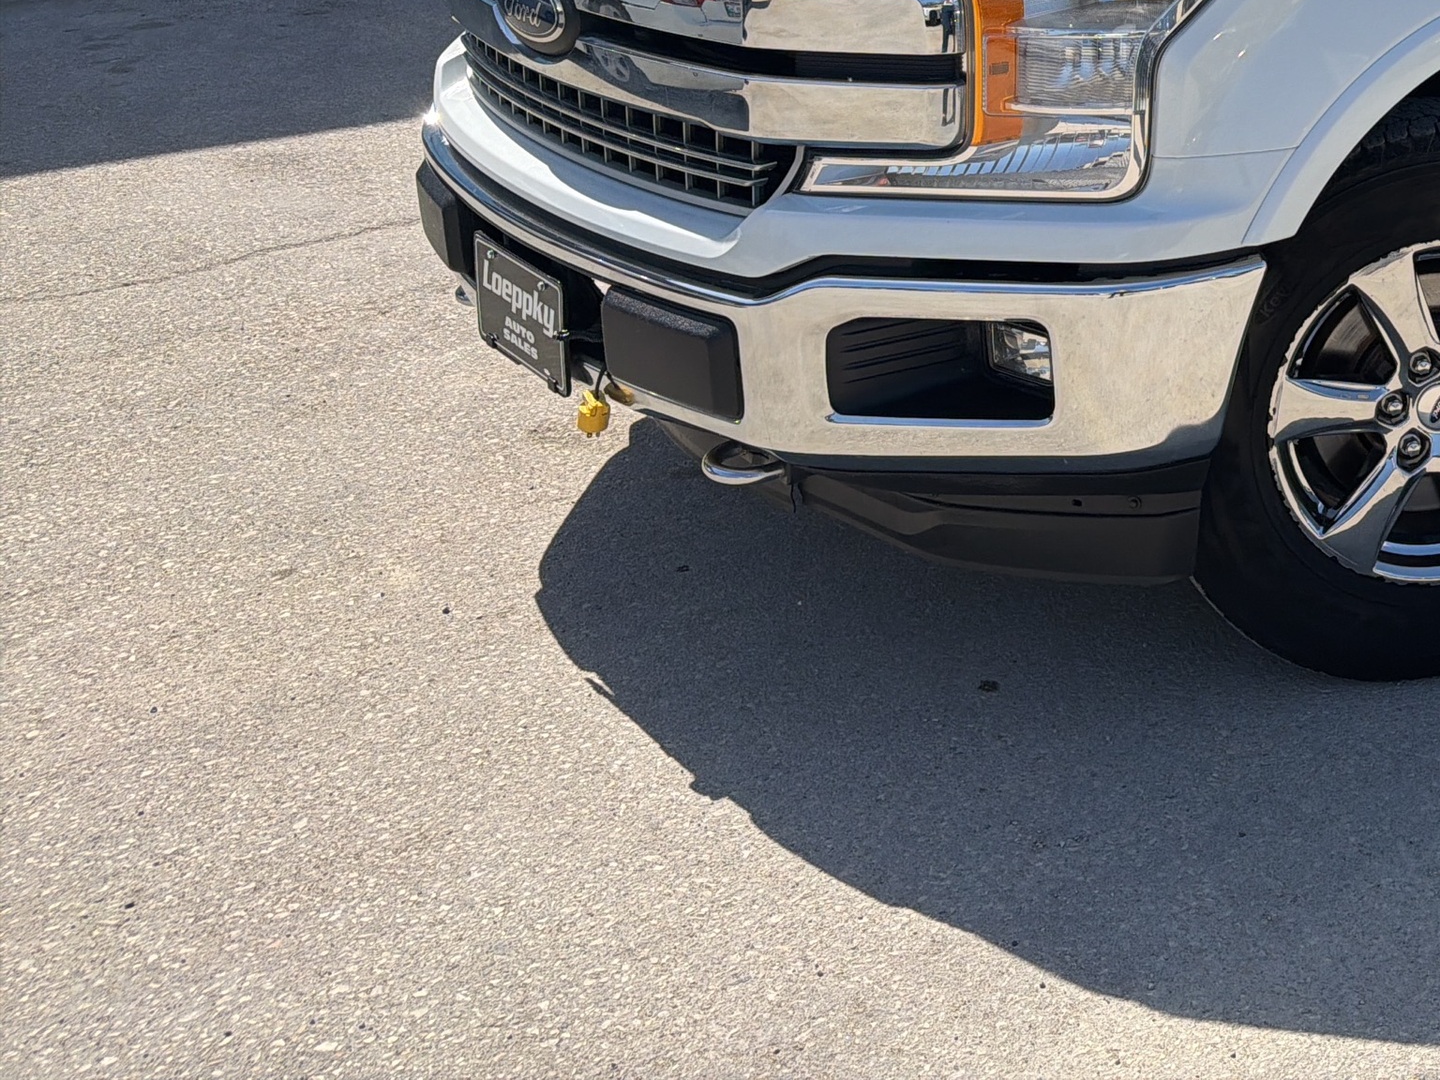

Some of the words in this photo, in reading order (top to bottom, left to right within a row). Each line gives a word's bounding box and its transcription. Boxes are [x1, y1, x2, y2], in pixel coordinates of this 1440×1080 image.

[482, 258, 556, 339] Loeppky
[502, 327, 539, 361] SALES
[504, 315, 536, 344] AUTO
